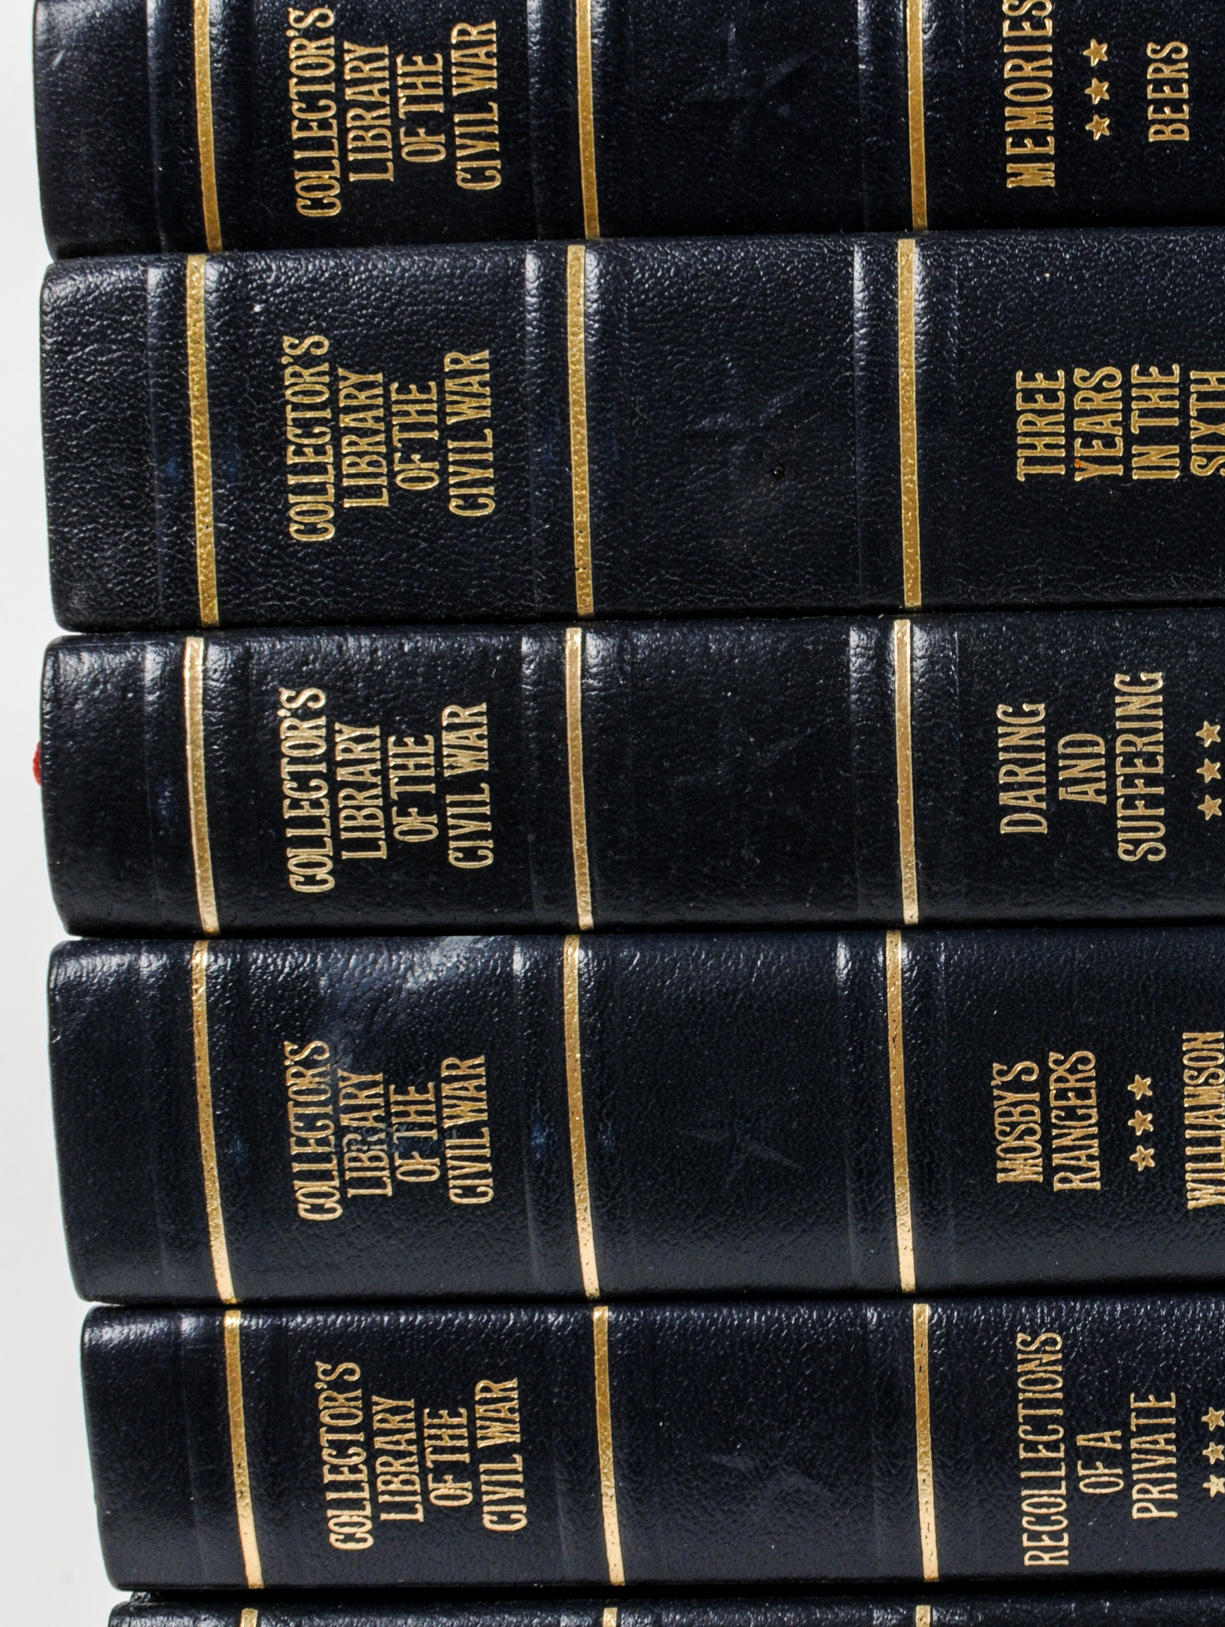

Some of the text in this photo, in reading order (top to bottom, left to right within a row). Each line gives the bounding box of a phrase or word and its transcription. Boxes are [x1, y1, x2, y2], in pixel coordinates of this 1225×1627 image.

[286, 7, 341, 217] COLLECTOR'S
[343, 40, 394, 182] LIBRARY
[396, 53, 447, 163] OF THE
[451, 20, 502, 190] CIVIL WAR
[1002, 0, 1055, 188] MEMORIES
[1146, 41, 1190, 142] BEERS
[281, 335, 336, 542] COLLECTOR'S
[338, 367, 389, 508] LIBRARY
[390, 381, 440, 491] OF THE
[443, 350, 496, 517] CIVIL WAR
[1016, 368, 1066, 482] THREE
[1073, 366, 1124, 482] YEARS
[1130, 363, 1181, 480] IN THE
[277, 687, 335, 893] COLLECTOR'S
[334, 721, 388, 861] LIBRARY
[388, 734, 439, 843] OF THE
[441, 702, 494, 869] CIVIL WAR
[996, 702, 1048, 834] DARING
[1057, 733, 1108, 805] AND
[1113, 671, 1167, 861] SUFFERING
[283, 1040, 343, 1221] COLLECTOR'S
[337, 1068, 393, 1198] LIBRARY
[389, 1081, 441, 1183] OF THE
[440, 1054, 494, 1205] CIVIL WAR
[990, 1060, 1044, 1183] MOSBY'S
[1048, 1050, 1101, 1192] RANGERS
[314, 1360, 374, 1550] COLLECTOR'S
[371, 1394, 424, 1522] LIBRARY
[423, 1407, 474, 1507] OF THE
[474, 1376, 528, 1532] CIVIL WAR
[1016, 1332, 1069, 1567] RECOLLECTIONS
[1076, 1430, 1124, 1495] OF A
[1130, 1391, 1178, 1520] PRIVATE
